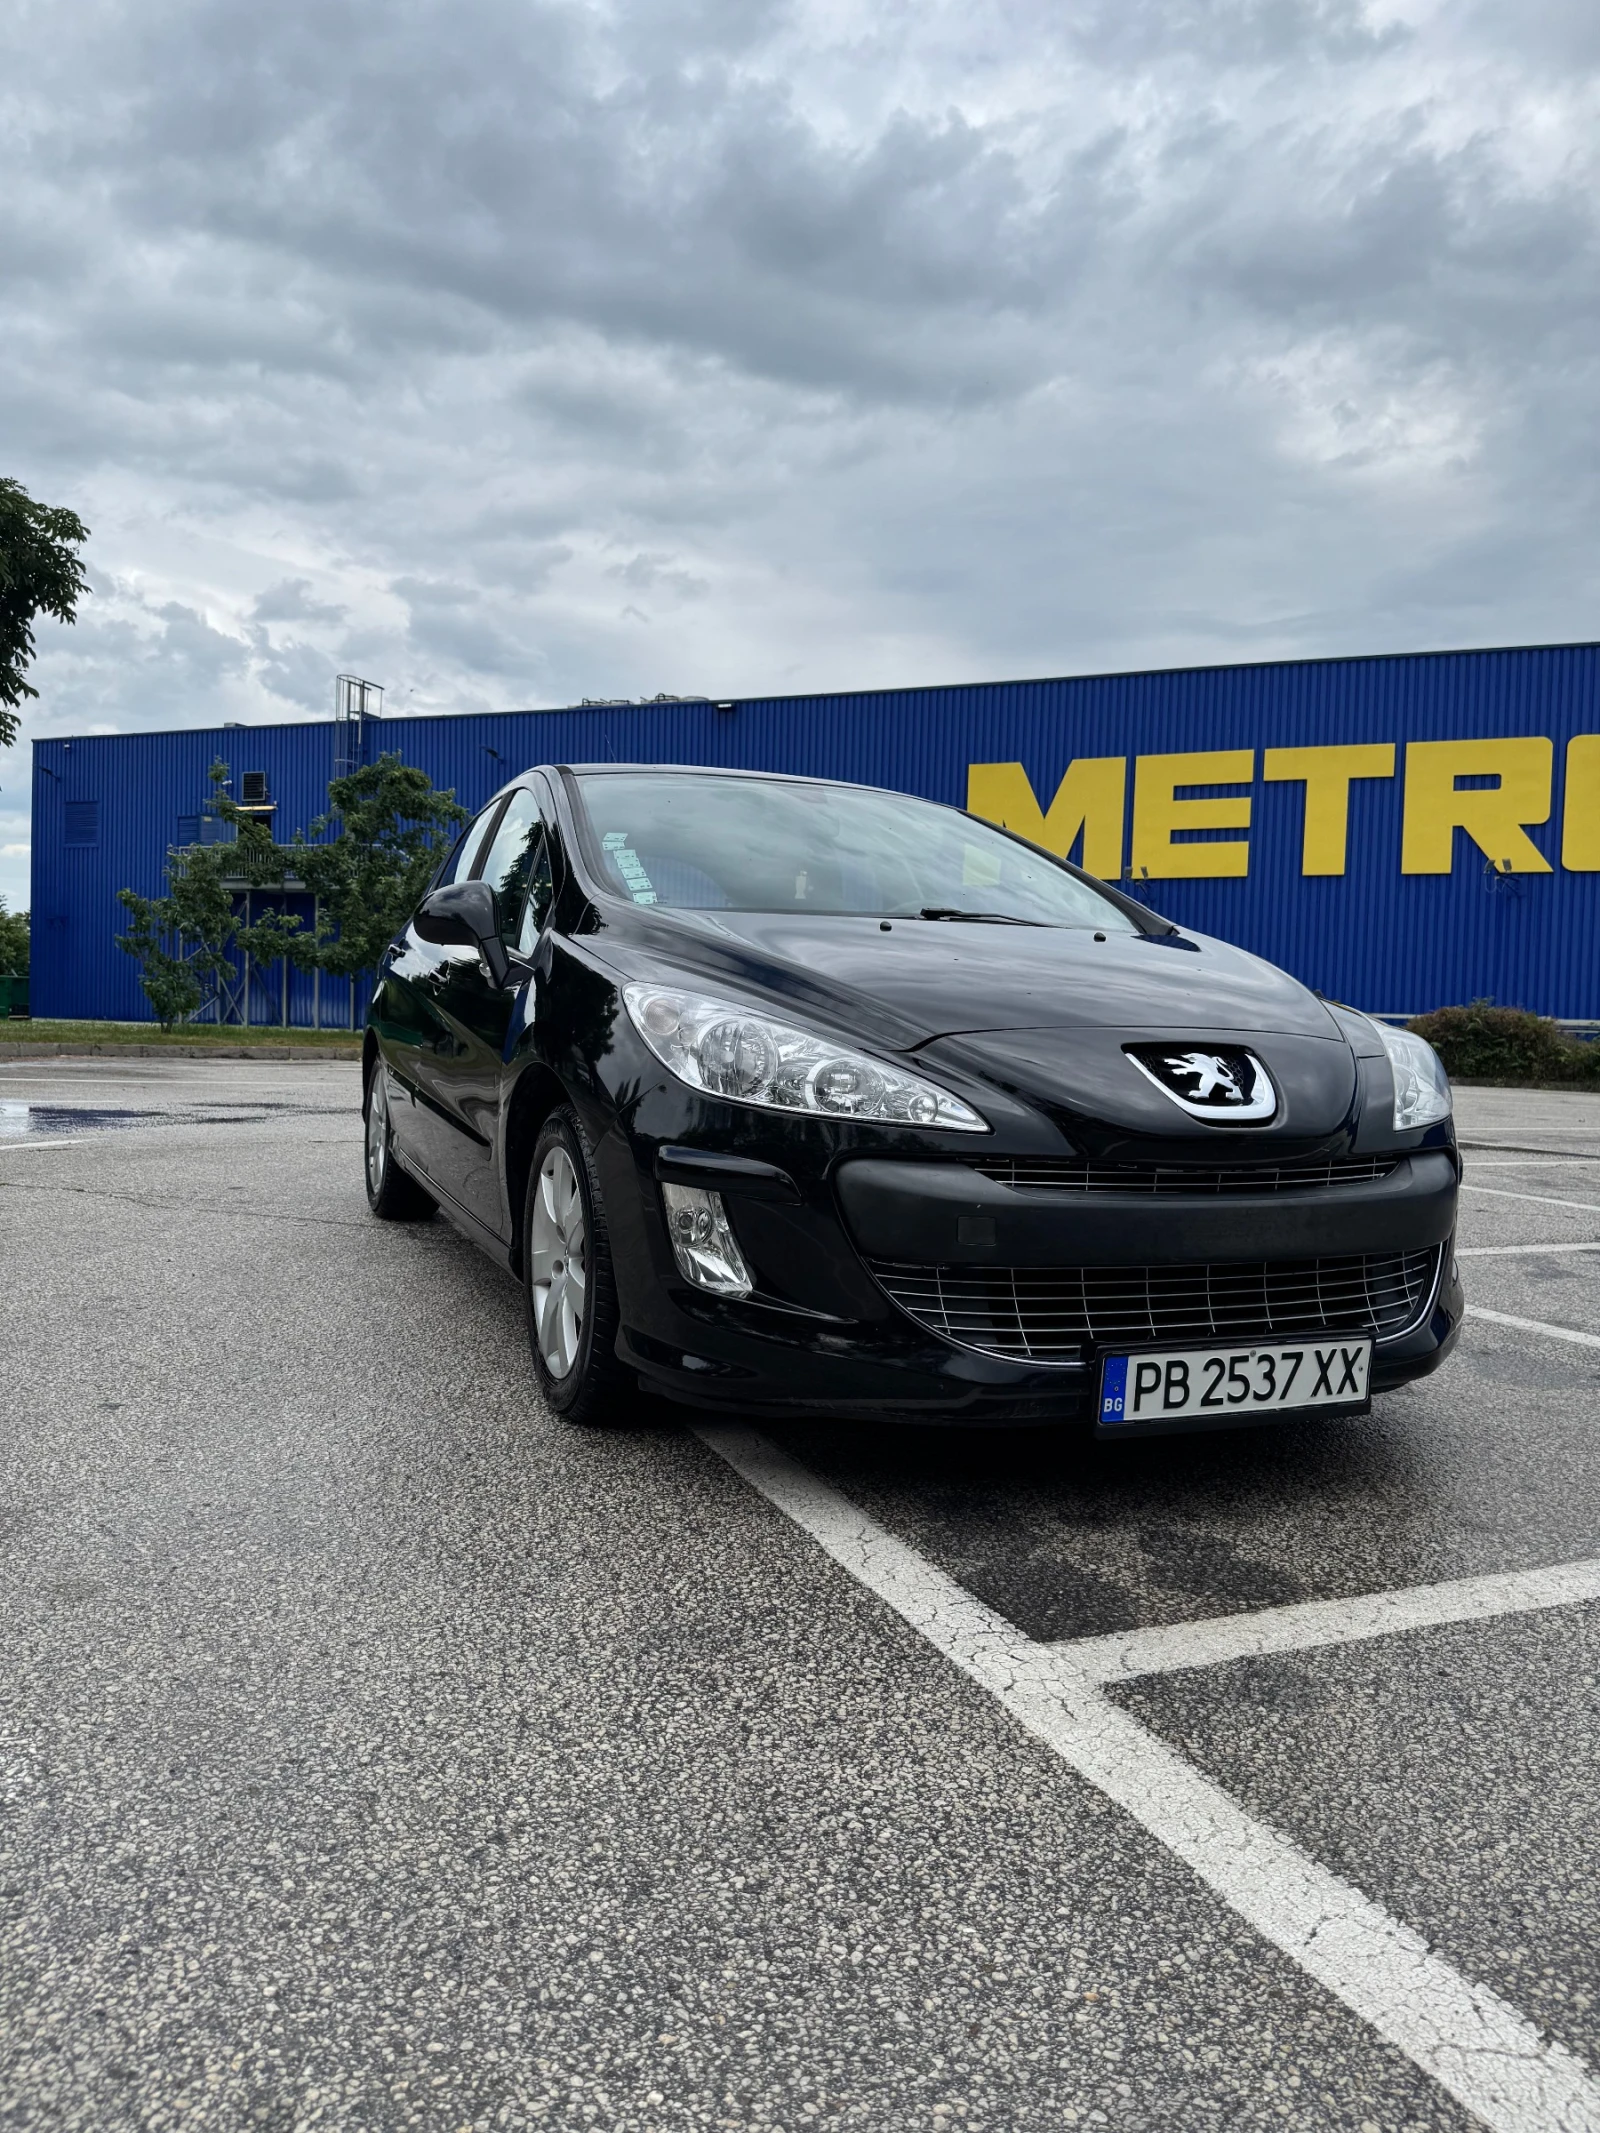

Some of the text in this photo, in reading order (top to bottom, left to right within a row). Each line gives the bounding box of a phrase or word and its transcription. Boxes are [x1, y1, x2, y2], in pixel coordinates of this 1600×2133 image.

[965, 734, 1600, 880] METR
[1103, 1397, 1123, 1413] BG
[1133, 1347, 1363, 1412] PB 2537 XX
